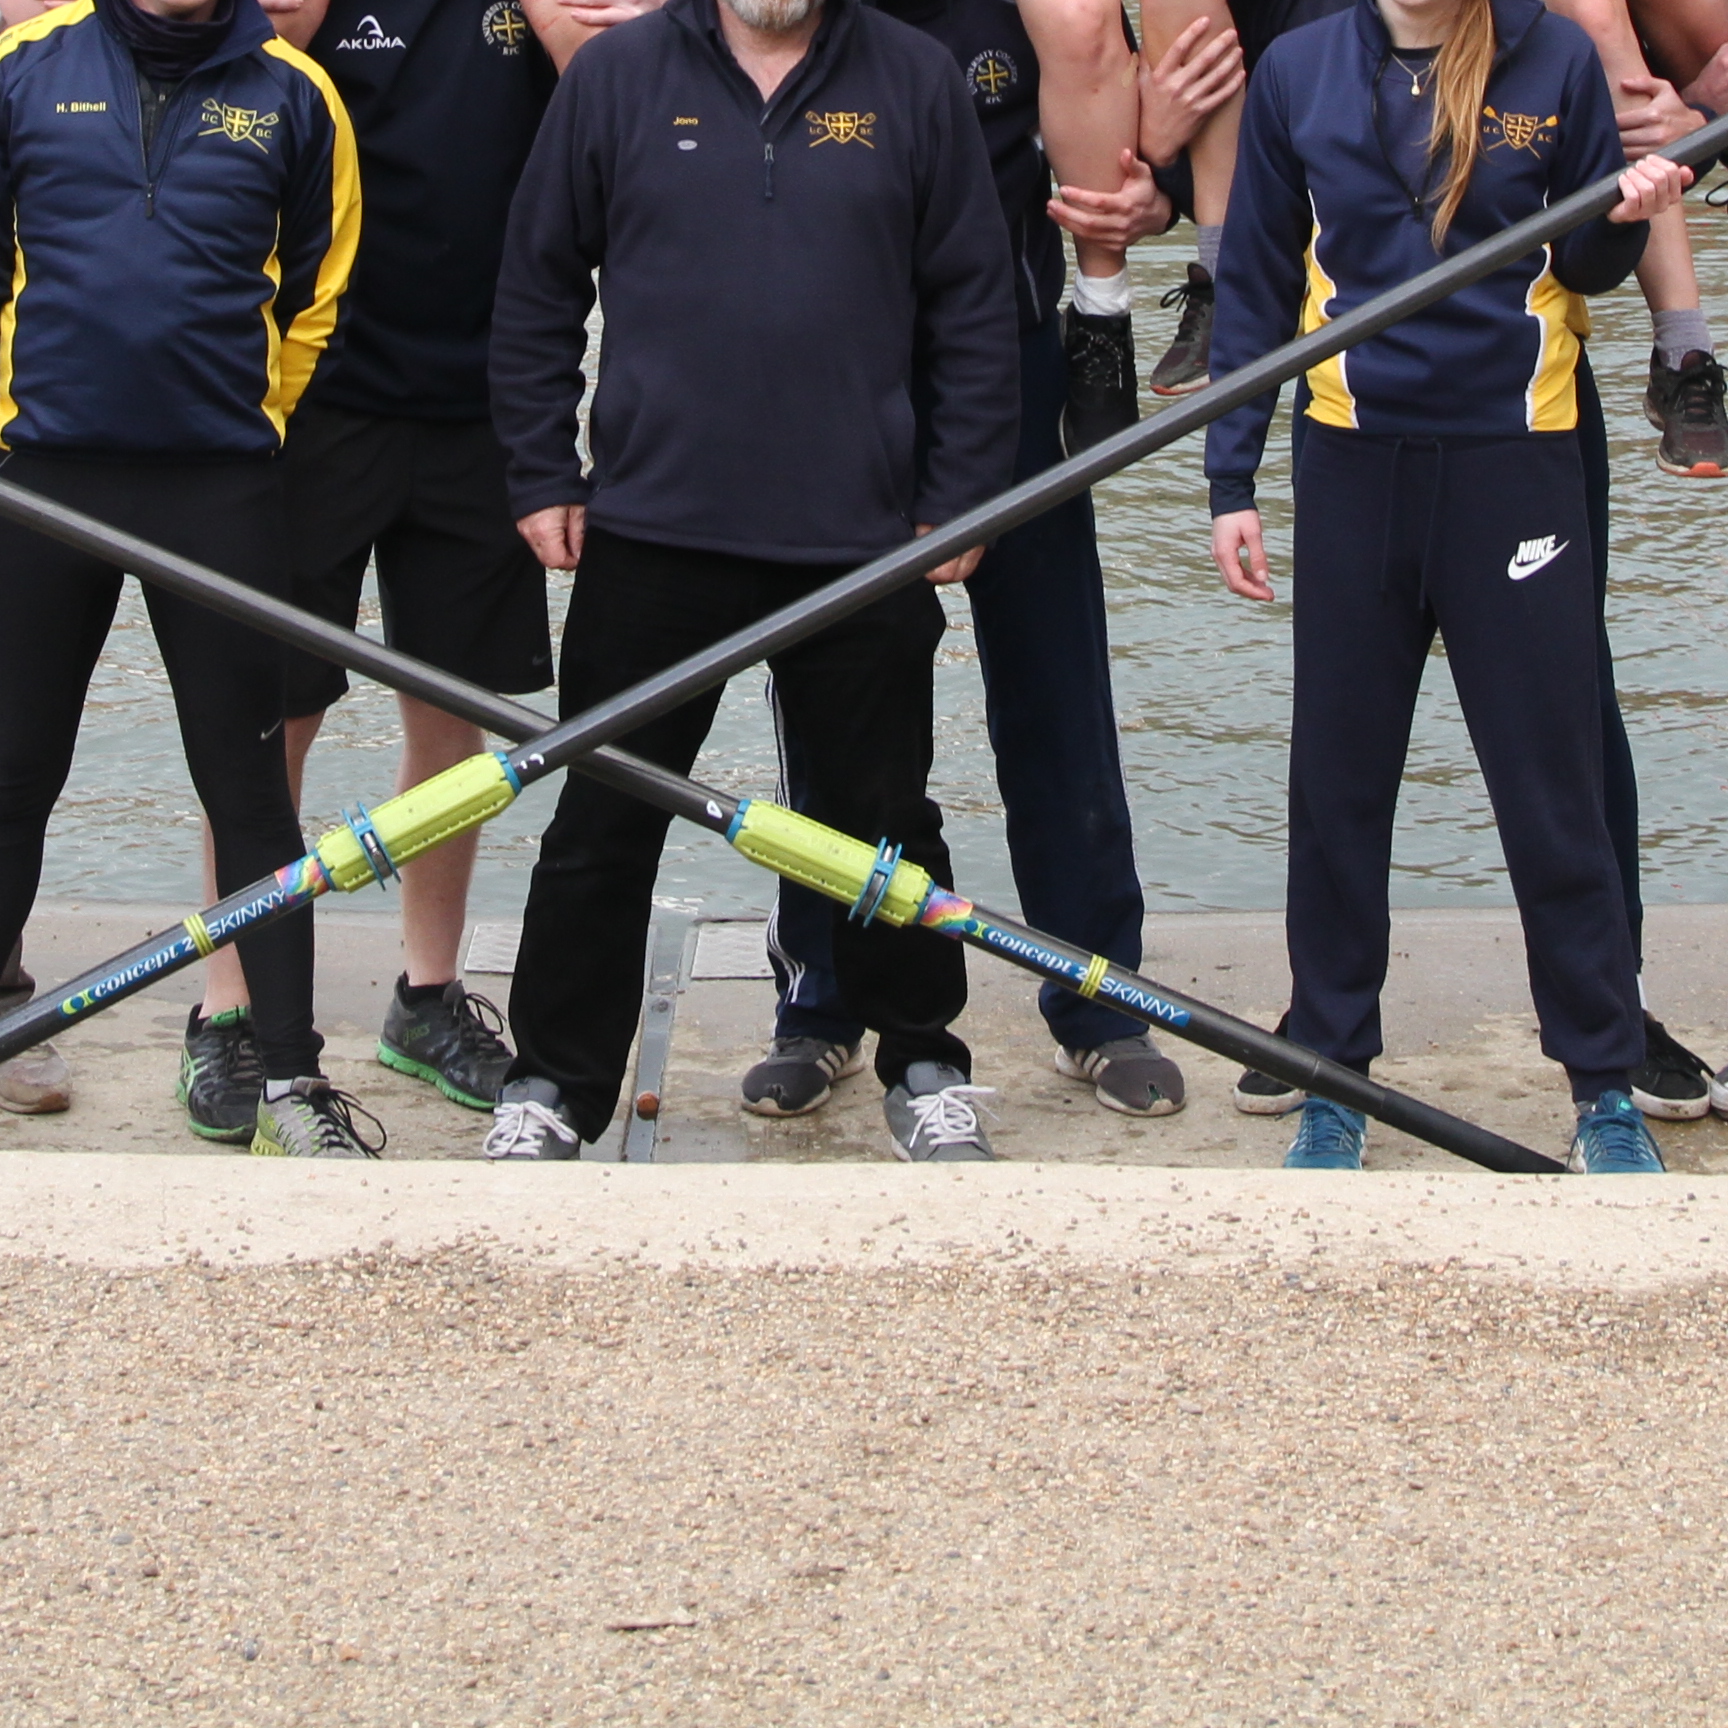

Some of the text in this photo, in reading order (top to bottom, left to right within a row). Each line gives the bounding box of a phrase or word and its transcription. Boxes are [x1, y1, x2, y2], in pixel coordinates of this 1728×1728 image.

[335, 36, 407, 51] AKUMA
[56, 102, 107, 113] H. Bithell
[201, 113, 218, 125] UC
[255, 128, 272, 140] BC
[1515, 534, 1557, 564] NIKE
[94, 889, 286, 999] concept 2 SKINNY
[986, 929, 1073, 974] concept
[1098, 976, 1186, 1023] SKINNY
